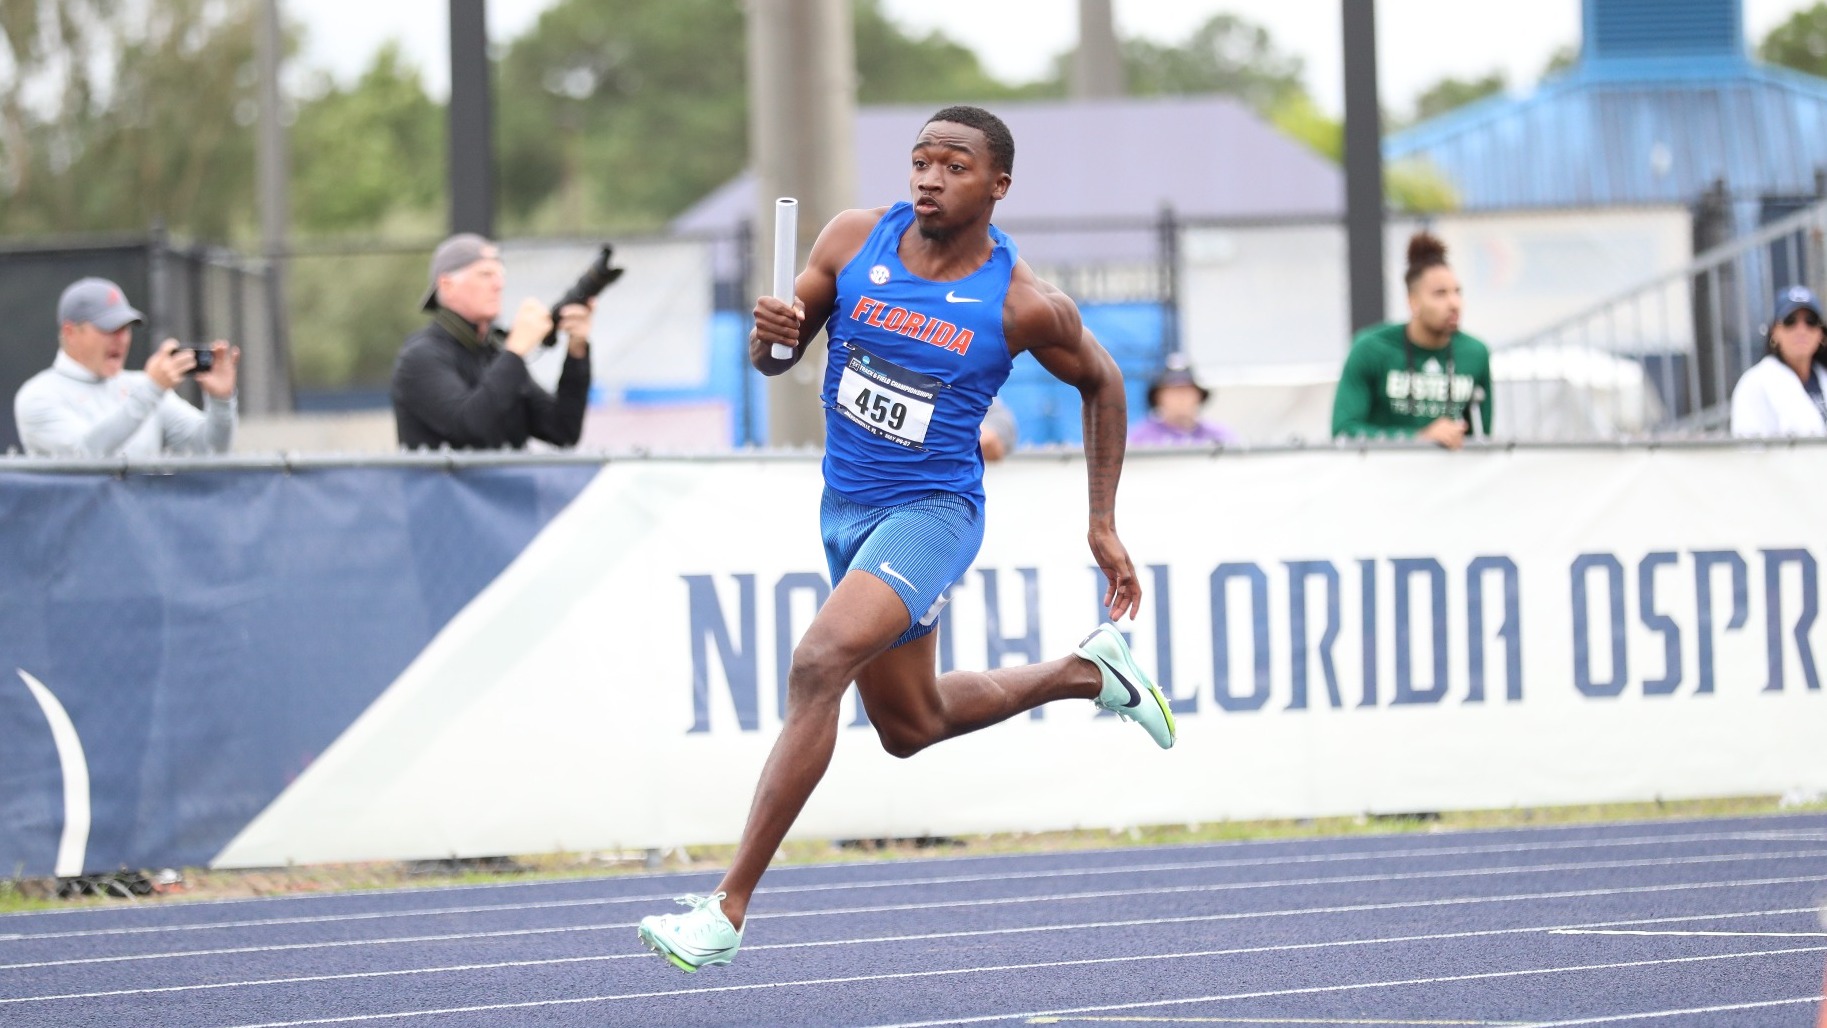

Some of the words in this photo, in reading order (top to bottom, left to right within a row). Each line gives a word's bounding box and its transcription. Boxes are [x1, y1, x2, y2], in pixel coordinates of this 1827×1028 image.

[850, 295, 975, 356] FLORIDA
[860, 364, 874, 377] TRACK
[877, 374, 891, 385] FIELD
[890, 380, 933, 400] CHAMPIONSHIPS
[855, 388, 907, 430] 459
[678, 567, 1044, 733] NOH
